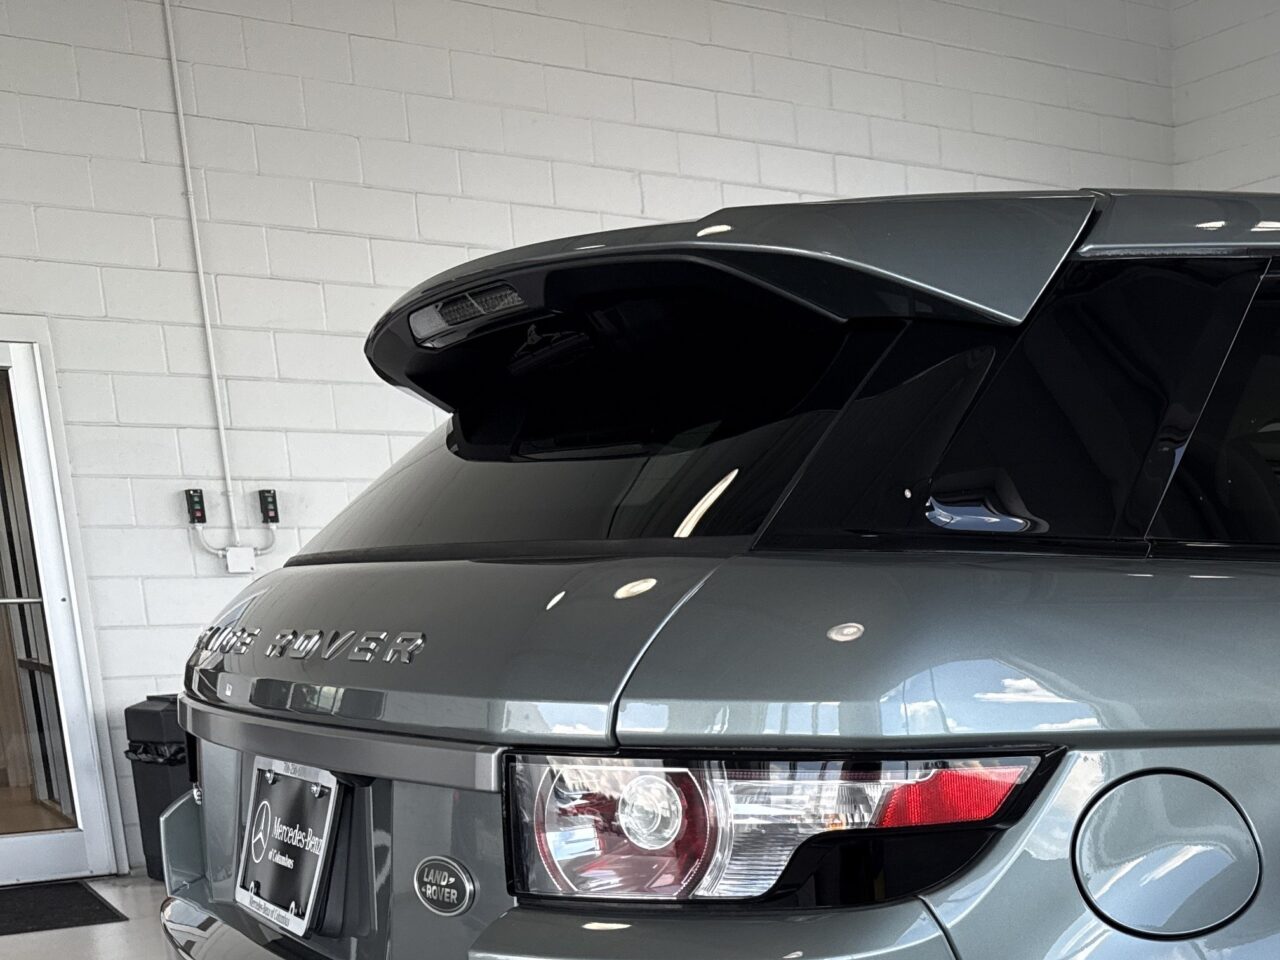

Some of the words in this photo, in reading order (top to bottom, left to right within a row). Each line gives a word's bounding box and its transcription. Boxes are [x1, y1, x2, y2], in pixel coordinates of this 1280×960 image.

[264, 628, 426, 664] ROVER
[423, 867, 449, 886] LAND
[426, 885, 458, 904] ROVER
